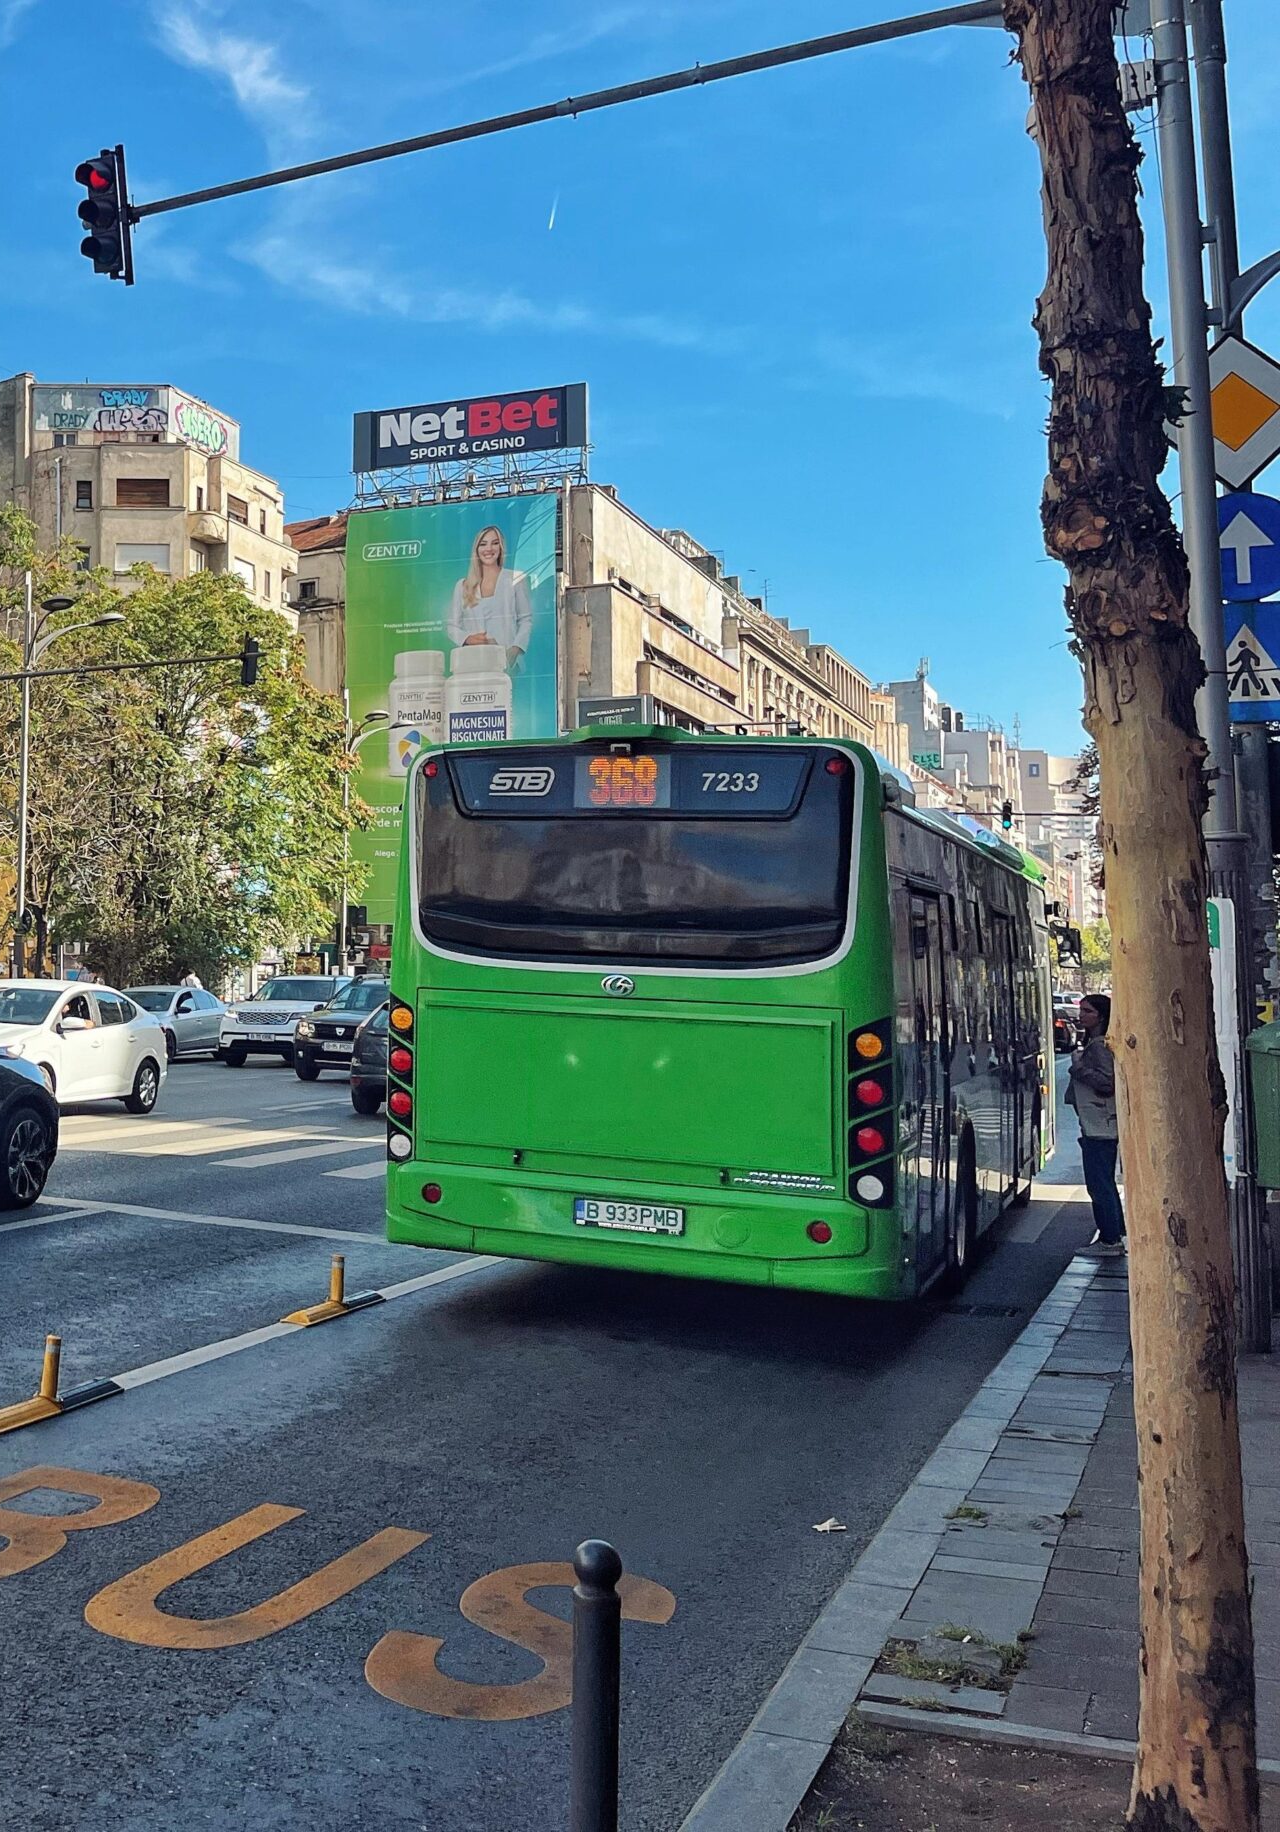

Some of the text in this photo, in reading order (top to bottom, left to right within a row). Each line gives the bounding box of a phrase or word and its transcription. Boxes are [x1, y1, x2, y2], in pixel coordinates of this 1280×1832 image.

[379, 394, 558, 448] NetBet
[410, 436, 525, 460] SPORT & CASINO
[367, 543, 417, 558] ZENYTH
[462, 694, 493, 703] ZENYTH
[397, 709, 442, 723] PentaMag
[451, 716, 505, 730] MAGNESIUM
[451, 730, 505, 742] BISGLYCINATE
[489, 770, 550, 793] STB
[702, 772, 760, 792] 7233
[586, 1202, 599, 1219] B
